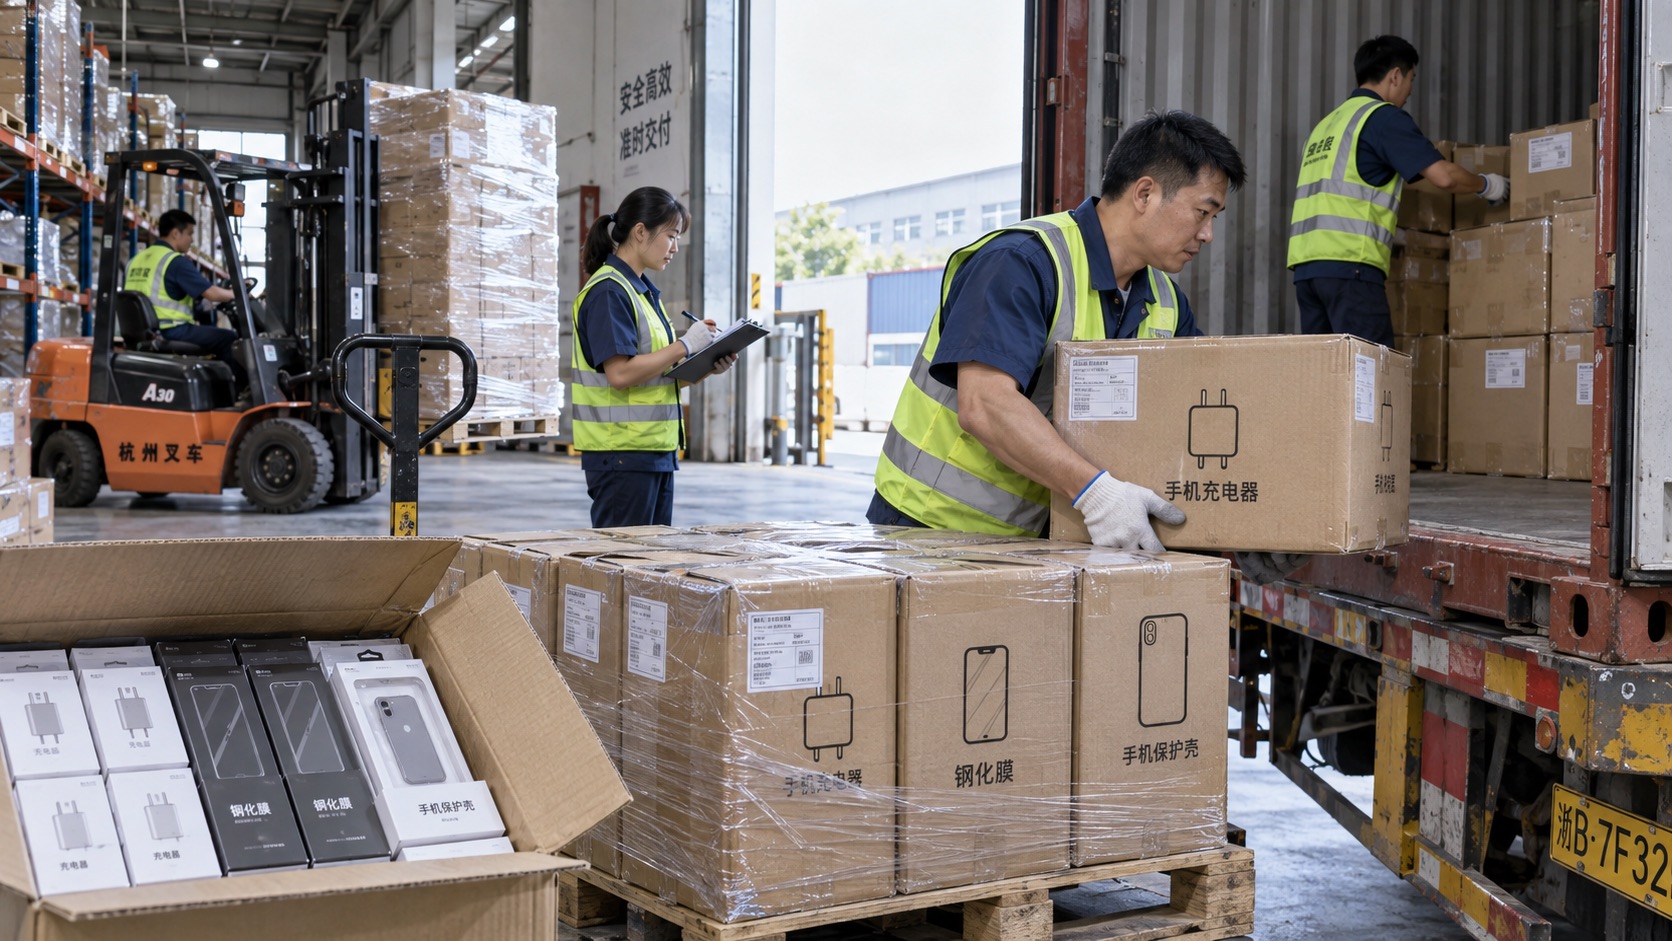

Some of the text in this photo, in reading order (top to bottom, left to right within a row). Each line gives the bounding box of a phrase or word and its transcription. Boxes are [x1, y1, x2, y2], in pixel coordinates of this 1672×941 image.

[620, 60, 672, 115] 安全高效
[620, 110, 671, 161] 准时交付
[142, 383, 175, 403] A30
[118, 442, 203, 464] 杭州叉车
[1165, 480, 1259, 503] 手机充电器
[1122, 738, 1199, 766] 手机保护壳
[955, 759, 1014, 788] 钢化膜
[419, 800, 475, 815] 手机保护壳
[1557, 801, 1672, 900] 浙B·7F32
